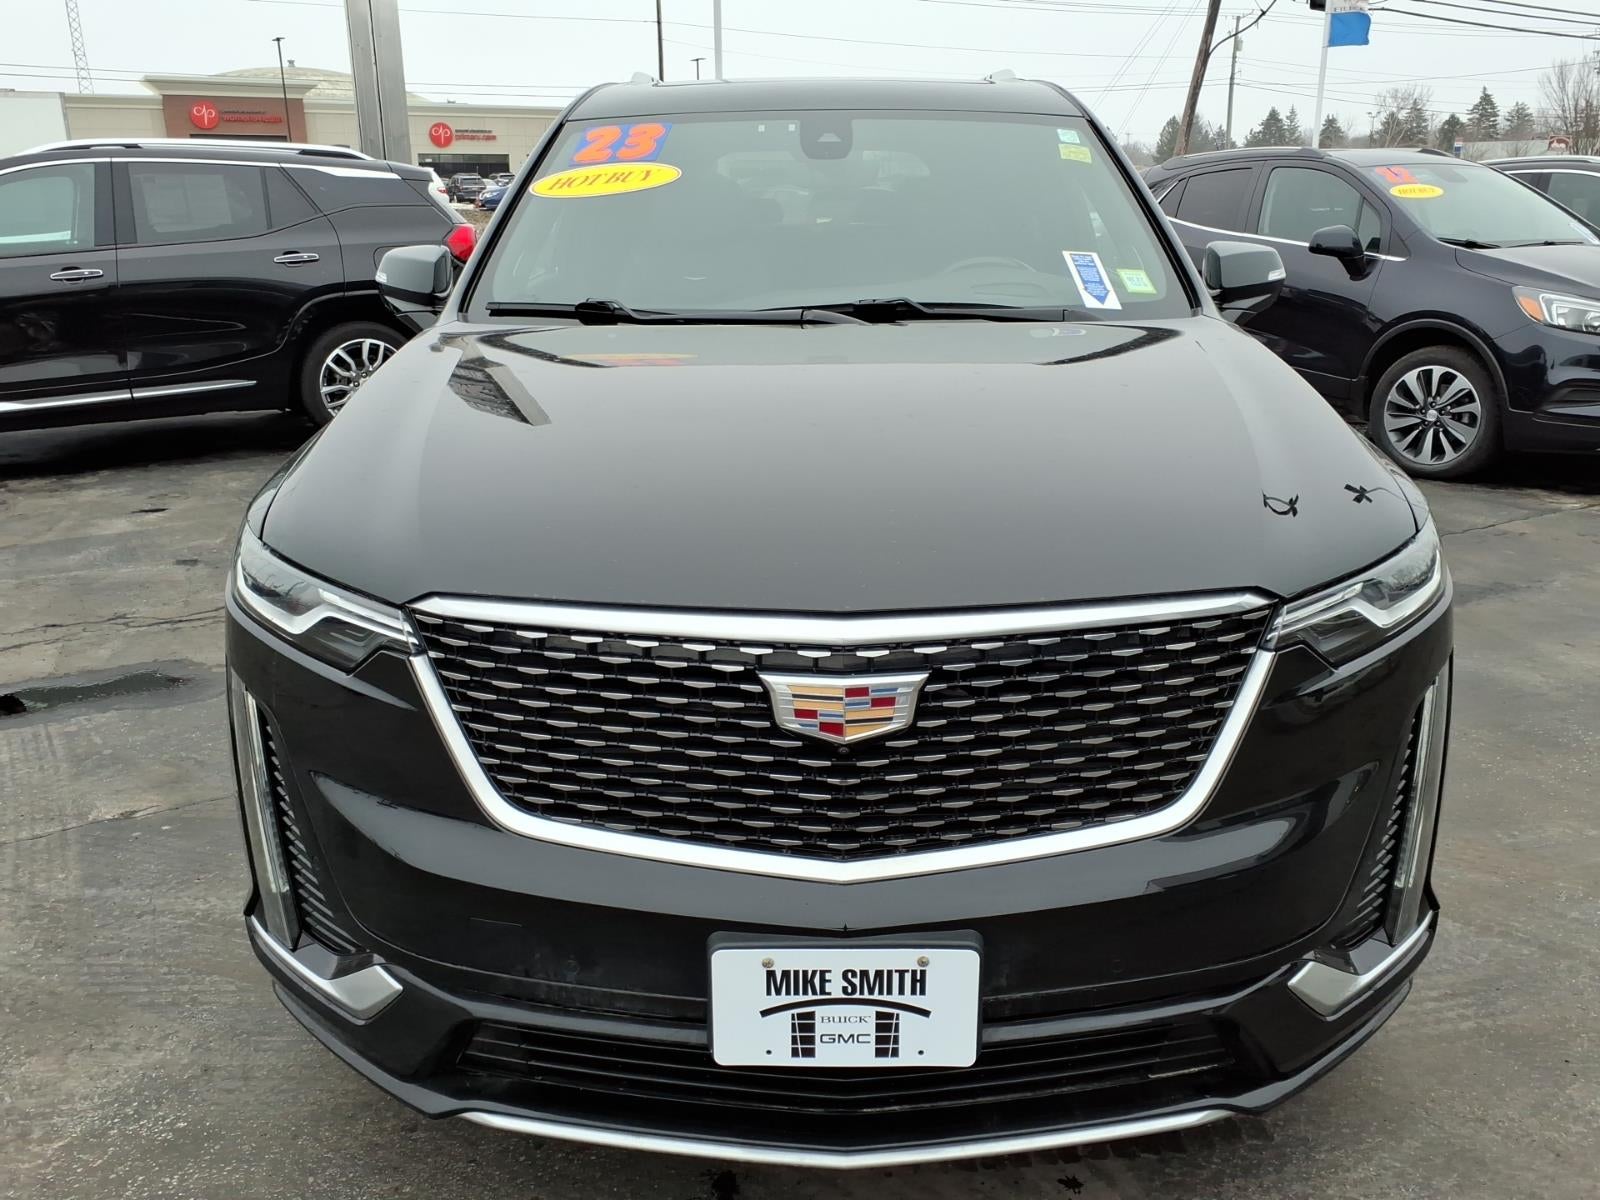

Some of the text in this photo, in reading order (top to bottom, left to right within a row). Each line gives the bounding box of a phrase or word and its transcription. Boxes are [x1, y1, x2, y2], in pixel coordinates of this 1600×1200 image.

[573, 123, 666, 163] 23
[766, 969, 927, 996] MIKE SMITH
[820, 1015, 869, 1024] BUICK
[820, 1033, 871, 1044] GMC
